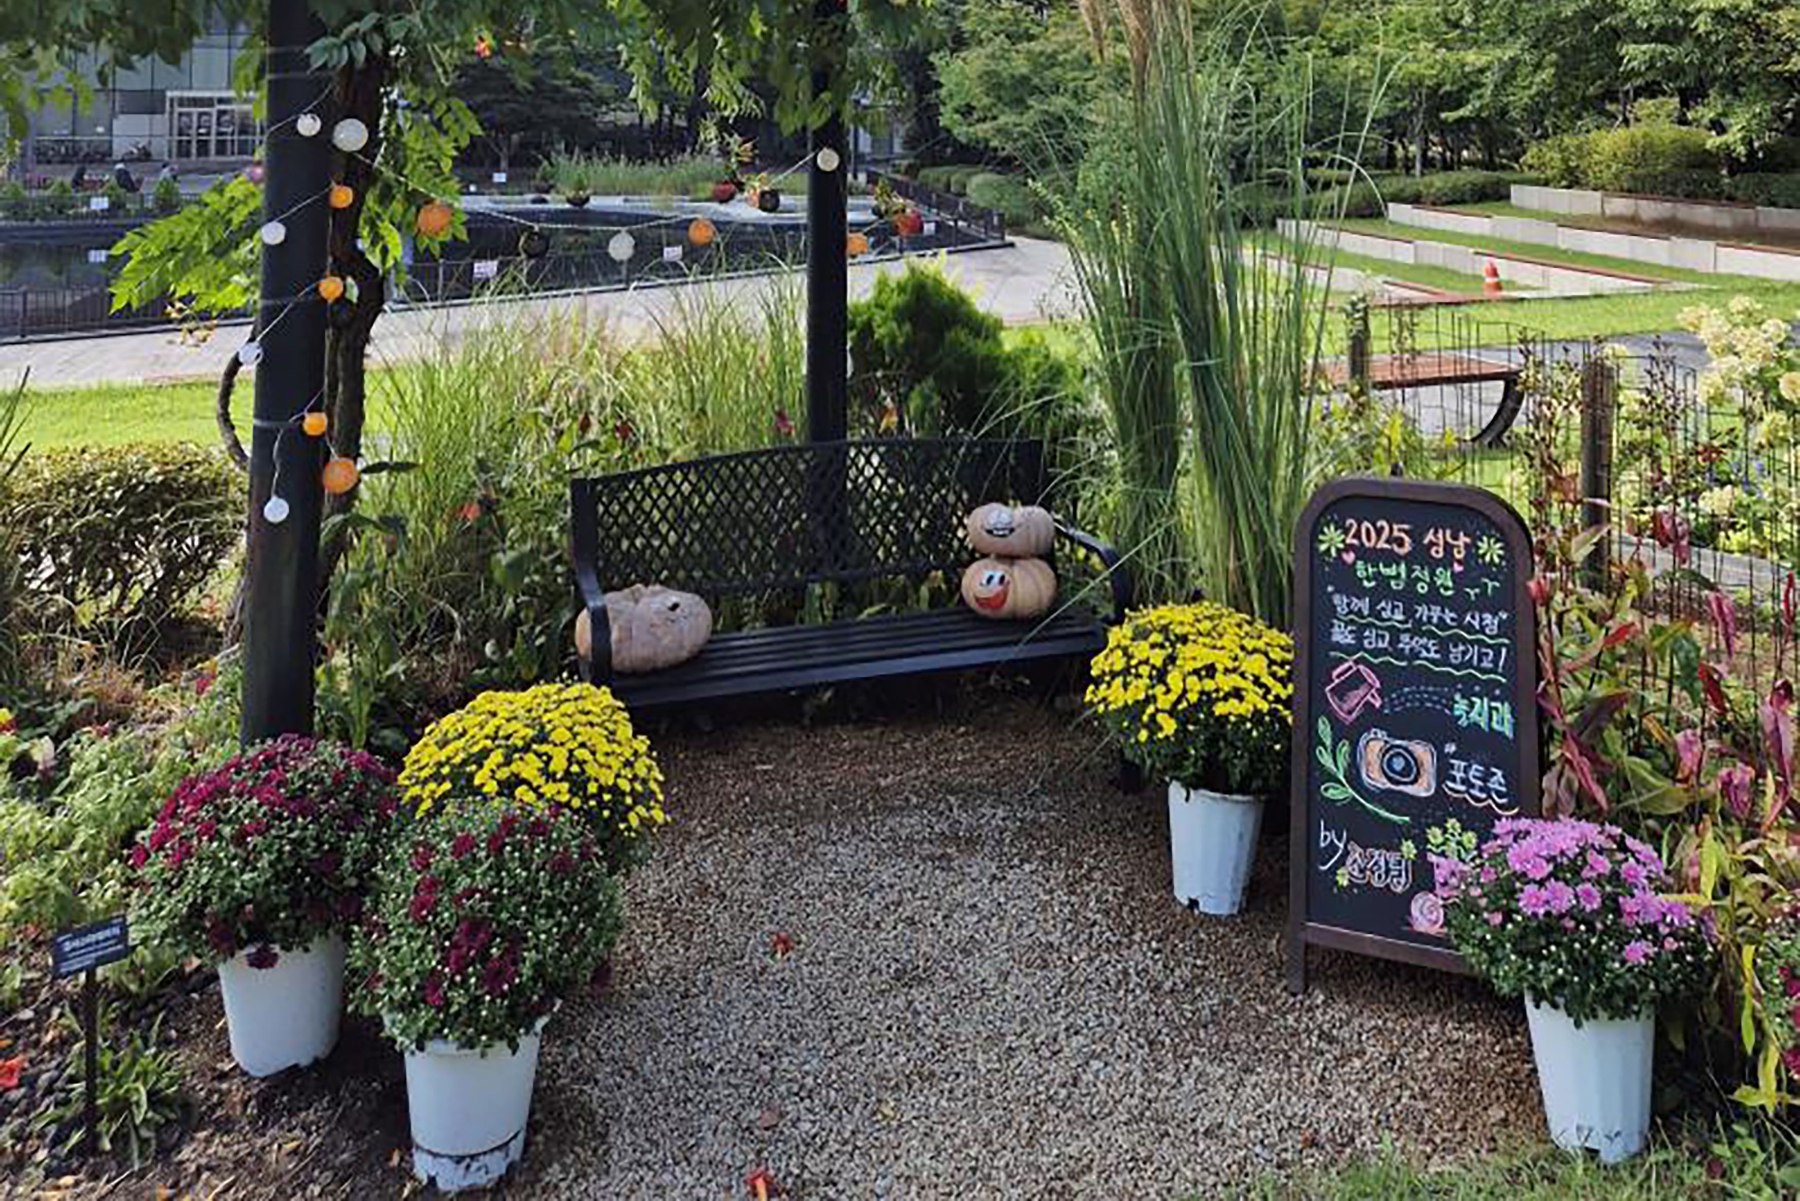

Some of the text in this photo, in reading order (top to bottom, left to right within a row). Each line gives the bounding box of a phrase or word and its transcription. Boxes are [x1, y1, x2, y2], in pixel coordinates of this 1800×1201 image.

[1345, 519, 1472, 558] 2025 성남
[1376, 600, 1406, 620] 심고
[1363, 628, 1390, 649] 심고
[1453, 693, 1513, 739] 녹지과
[1445, 759, 1508, 803] 포토존
[1319, 819, 1346, 870] by
